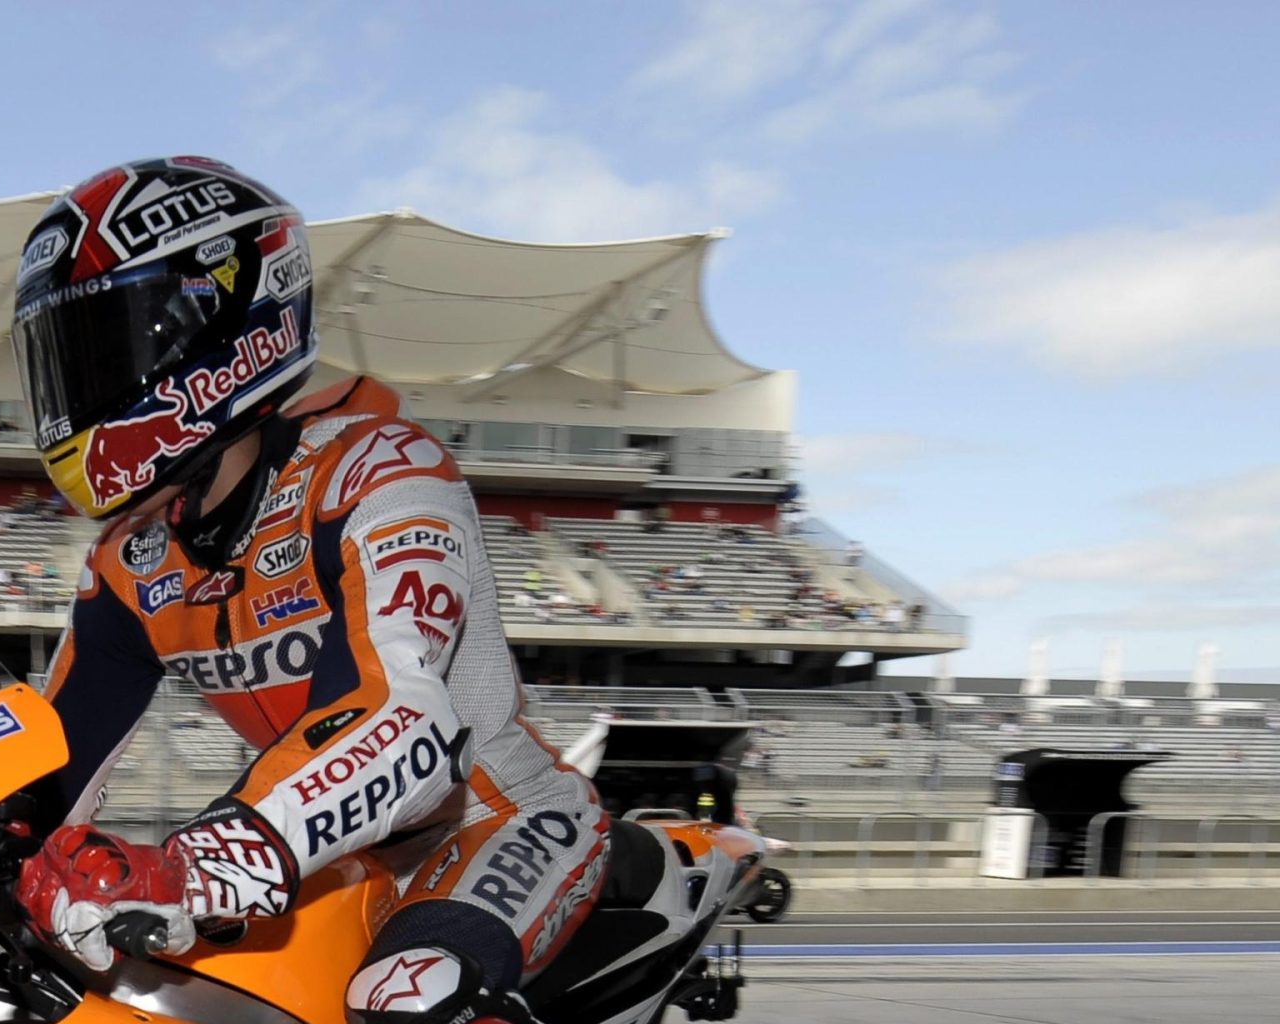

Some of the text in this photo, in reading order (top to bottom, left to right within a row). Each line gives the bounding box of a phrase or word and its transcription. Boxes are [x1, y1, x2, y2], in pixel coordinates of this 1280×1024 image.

[118, 182, 236, 248] LOTUS
[201, 239, 231, 260] SHOEI
[272, 254, 310, 293] SHOEI
[47, 275, 113, 307] WINGS
[185, 306, 301, 416] Red Bull
[38, 419, 73, 447] LOTUS
[376, 530, 465, 560] REPSOL
[148, 576, 183, 608] GAS
[249, 577, 321, 628] HRC
[169, 625, 326, 691] REPSO
[290, 704, 424, 806] HONDA
[304, 720, 456, 858] REPSOL
[471, 809, 582, 919] REPSO
